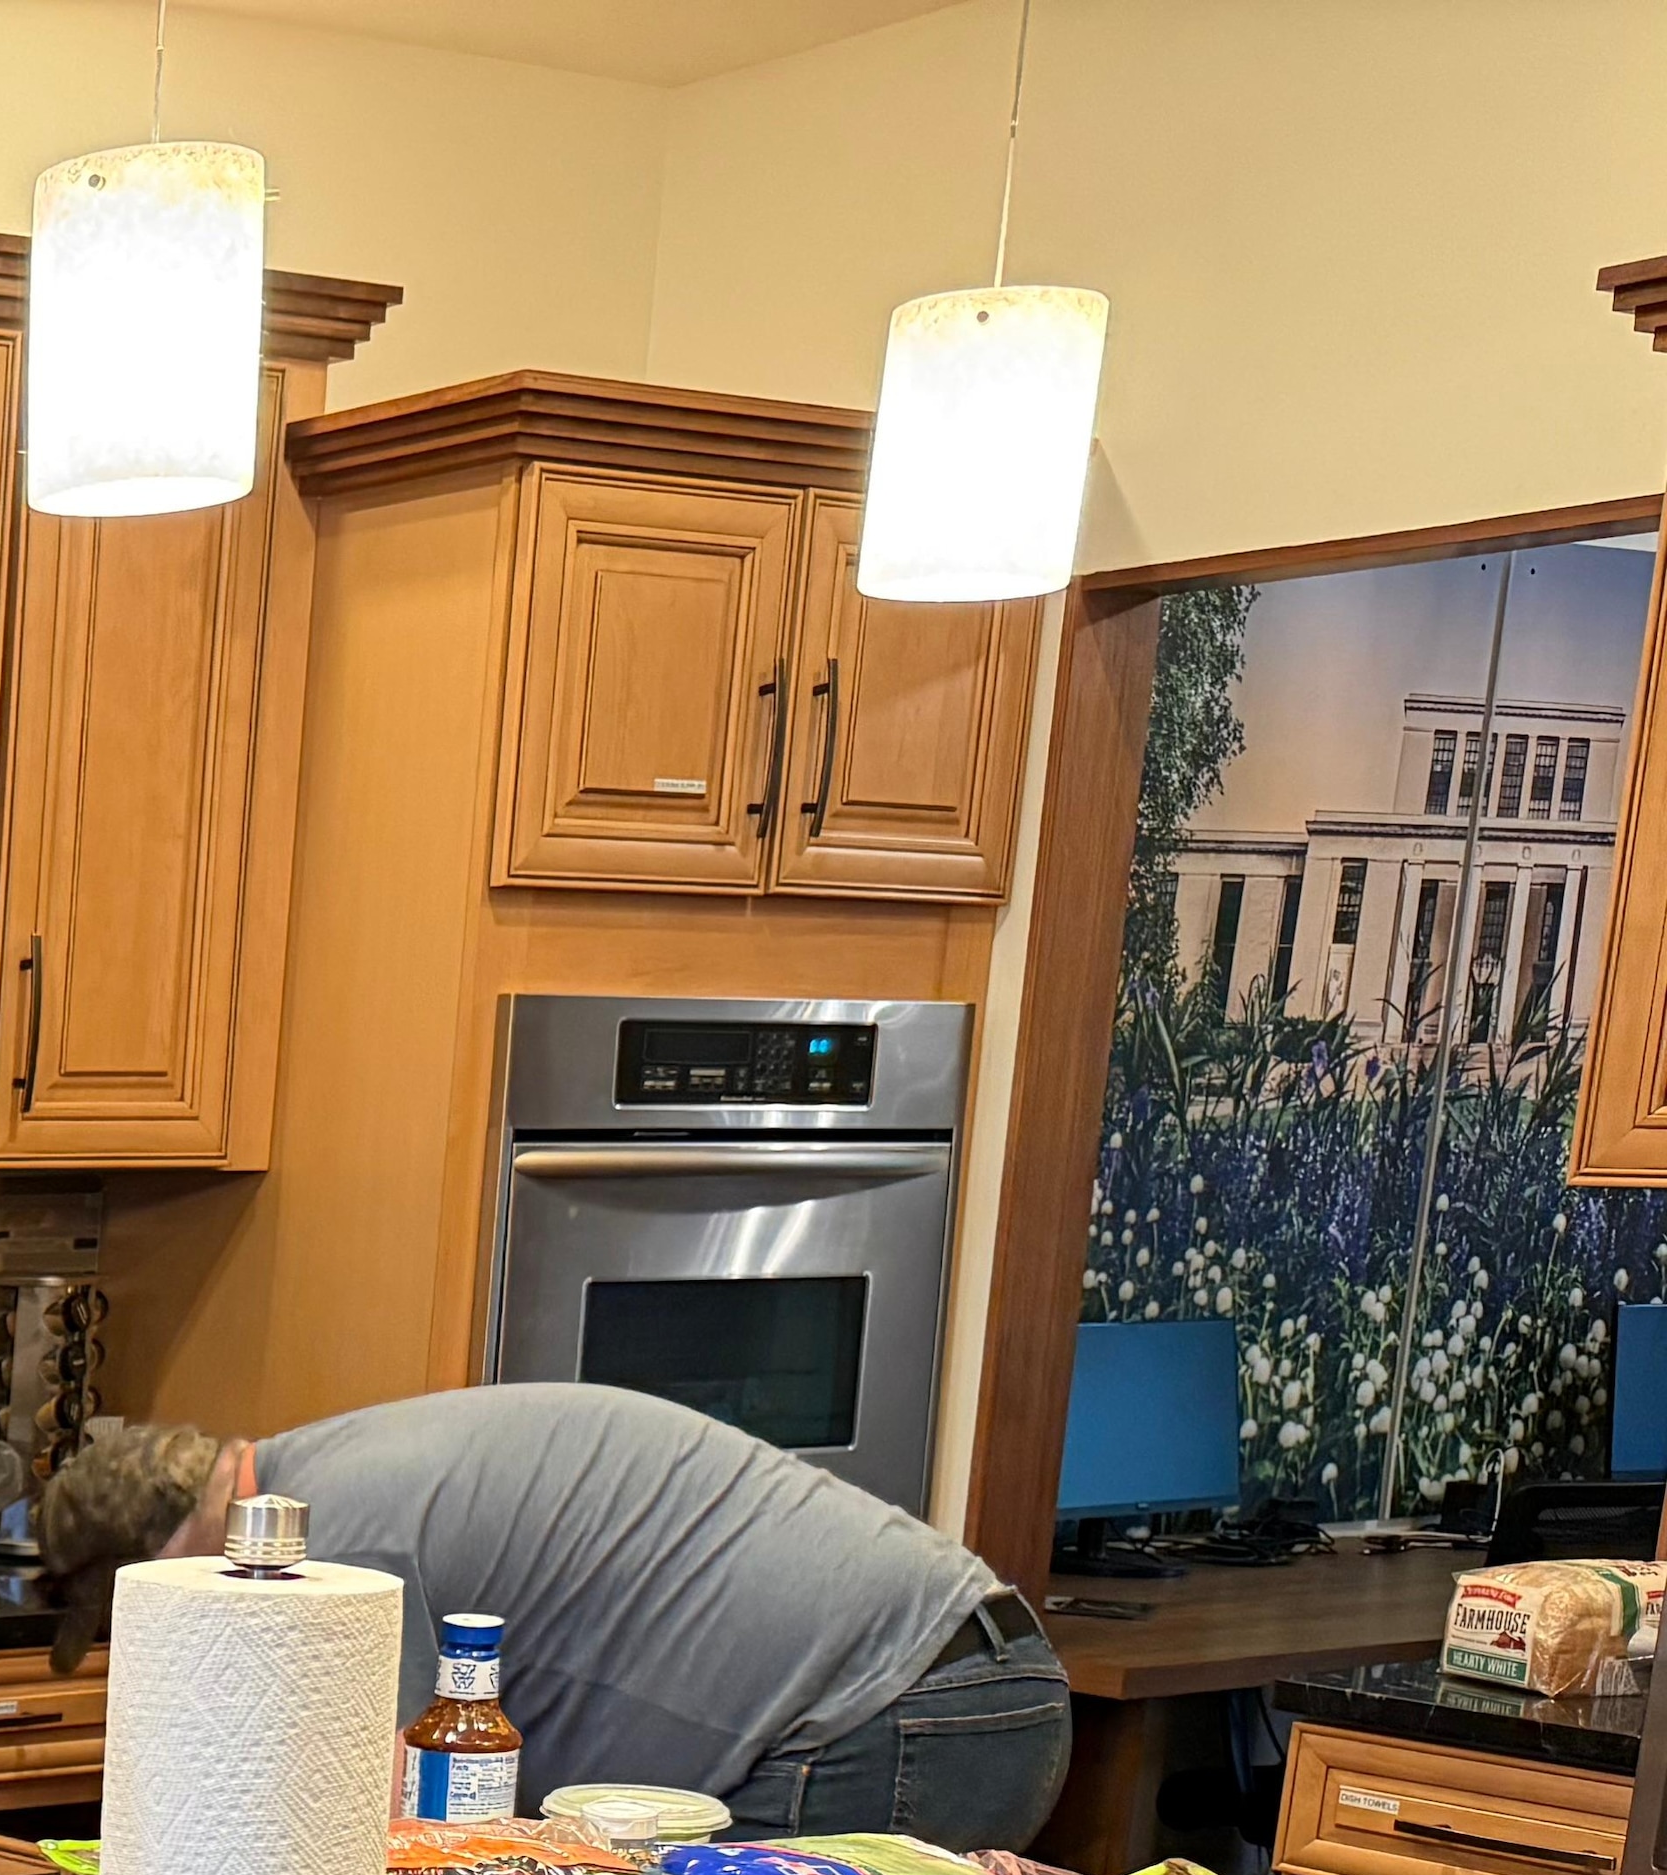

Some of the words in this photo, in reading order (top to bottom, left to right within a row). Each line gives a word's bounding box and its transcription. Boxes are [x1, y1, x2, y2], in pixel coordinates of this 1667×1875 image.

[1454, 1603, 1531, 1634] FARMHOUSE
[1452, 1650, 1487, 1671] HEARTY
[1487, 1657, 1519, 1677] WHITE
[1341, 1793, 1361, 1804] DISH
[1363, 1797, 1398, 1812] TOWELS
